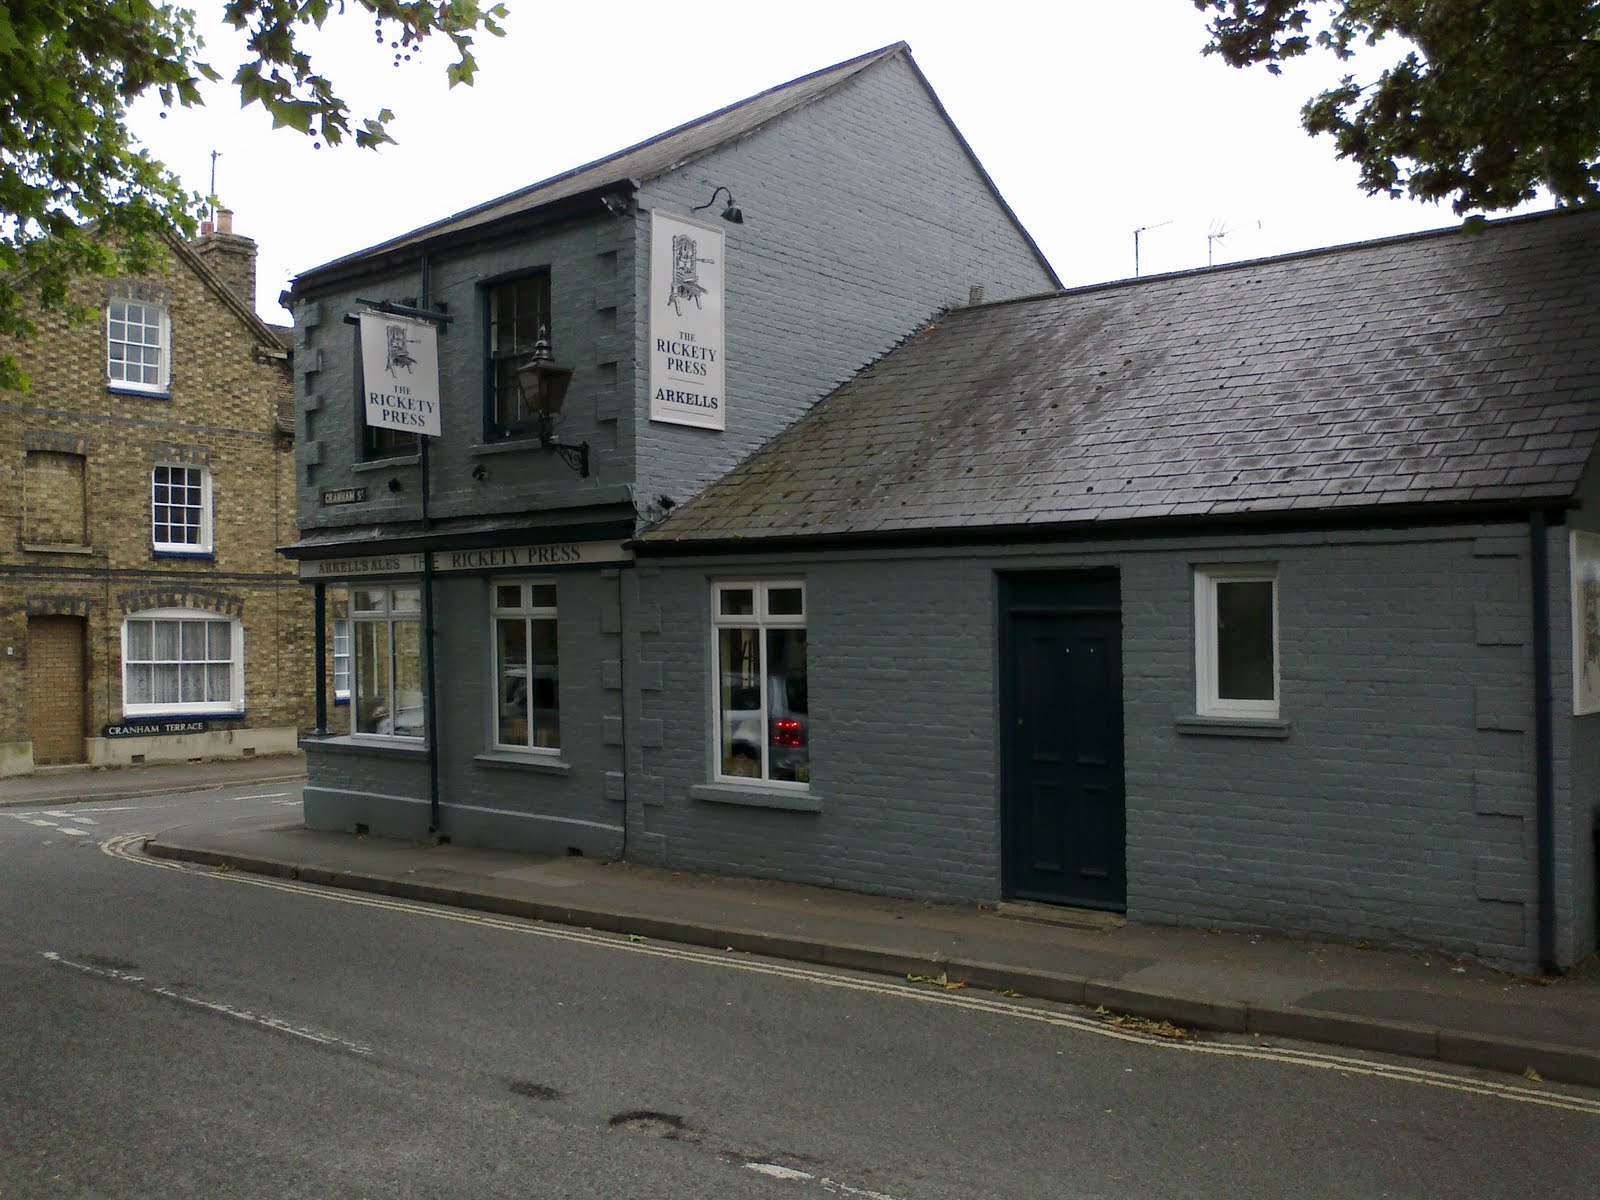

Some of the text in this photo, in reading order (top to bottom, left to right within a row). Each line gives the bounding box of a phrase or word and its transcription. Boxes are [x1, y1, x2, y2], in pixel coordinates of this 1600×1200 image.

[679, 331, 696, 342] THE
[657, 338, 717, 362] RICKETY
[667, 357, 707, 376] PRESS
[394, 385, 411, 395] THE
[655, 387, 718, 410] ARKELLS
[369, 392, 434, 413] RICKETY
[382, 409, 425, 427] PRESS
[325, 490, 355, 504] CRANHAM
[371, 558, 400, 571] ALES
[451, 549, 520, 568] RICKETY
[527, 543, 581, 563] PRESS
[108, 722, 203, 735] CRANHAM TERRACE
